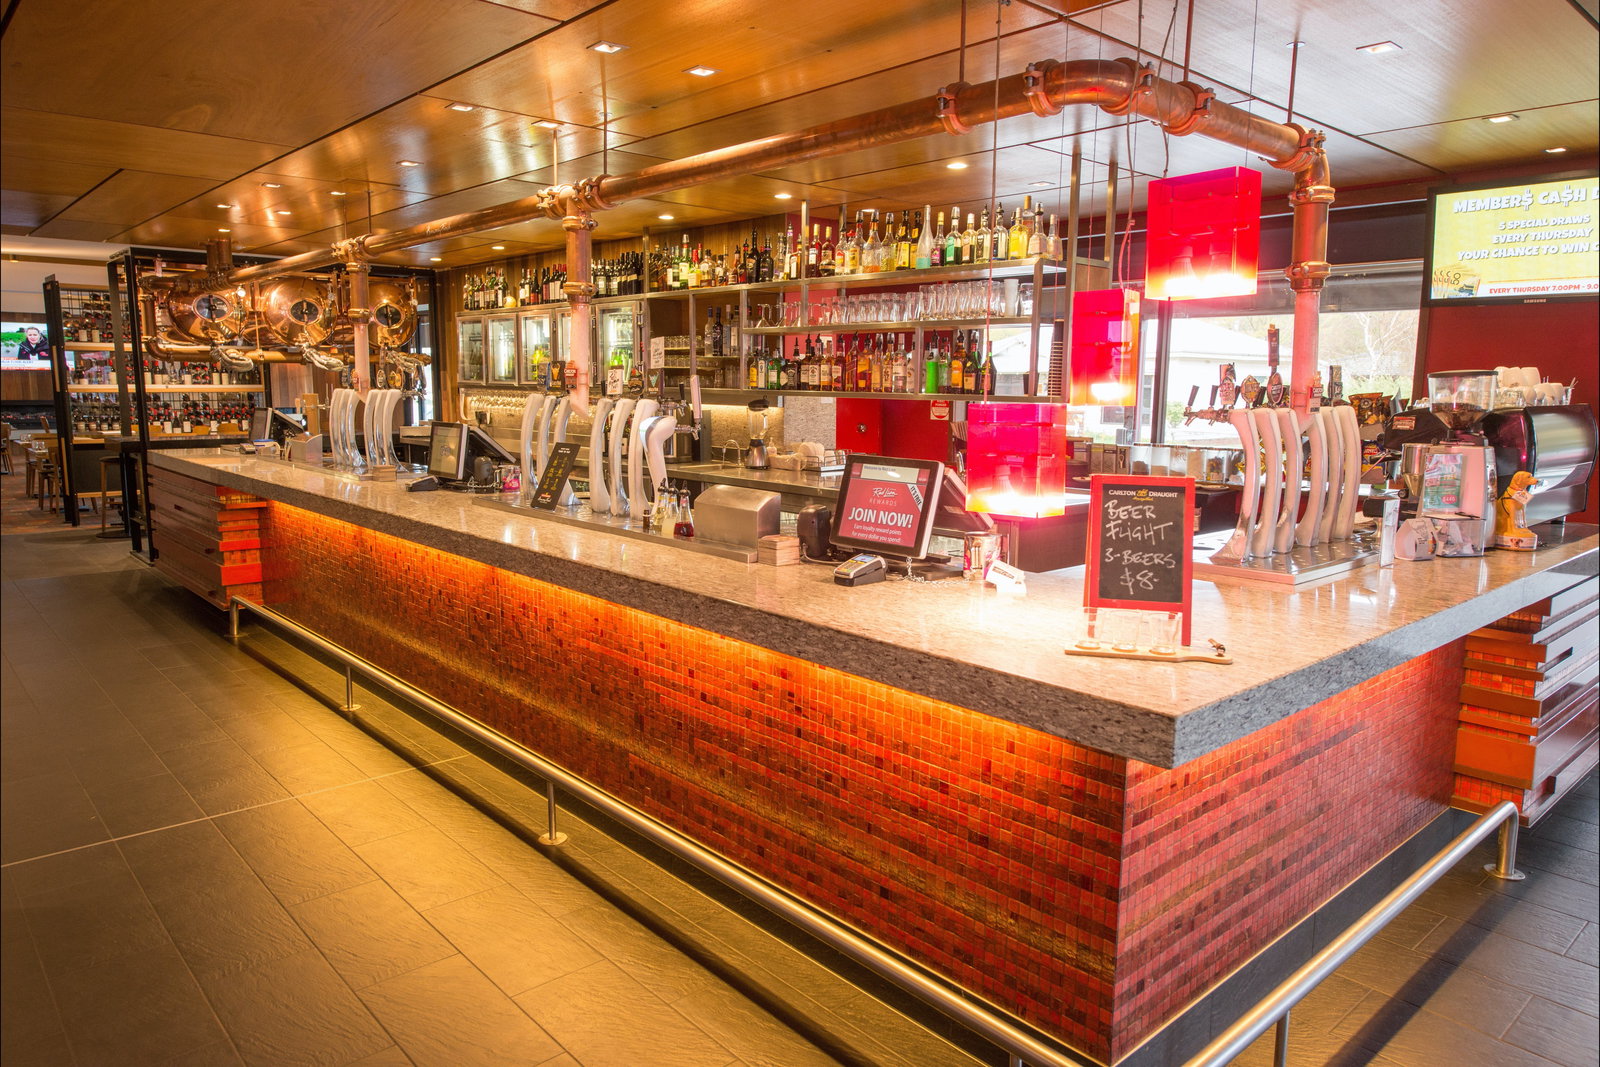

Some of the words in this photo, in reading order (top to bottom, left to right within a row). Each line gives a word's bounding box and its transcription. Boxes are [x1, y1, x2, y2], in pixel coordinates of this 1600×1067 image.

[1454, 189, 1534, 213] MEMBER$
[1538, 185, 1587, 207] CA$H
[1499, 221, 1506, 230] 5
[1507, 218, 1548, 229] SPECIAL
[1549, 214, 1590, 226] DRAWS
[1491, 233, 1528, 244] EVERY
[1530, 228, 1593, 241] THURSDAY
[1457, 249, 1490, 261] YOUR
[1491, 245, 1539, 258] CHANCE
[1541, 244, 1559, 255] TO
[1561, 242, 1590, 253] WIN
[1513, 285, 1551, 293] THURSDAY
[869, 498, 897, 506] REWARDS
[1104, 499, 1156, 520] BEER
[848, 507, 877, 523] JOIN
[878, 510, 913, 529] NOW!
